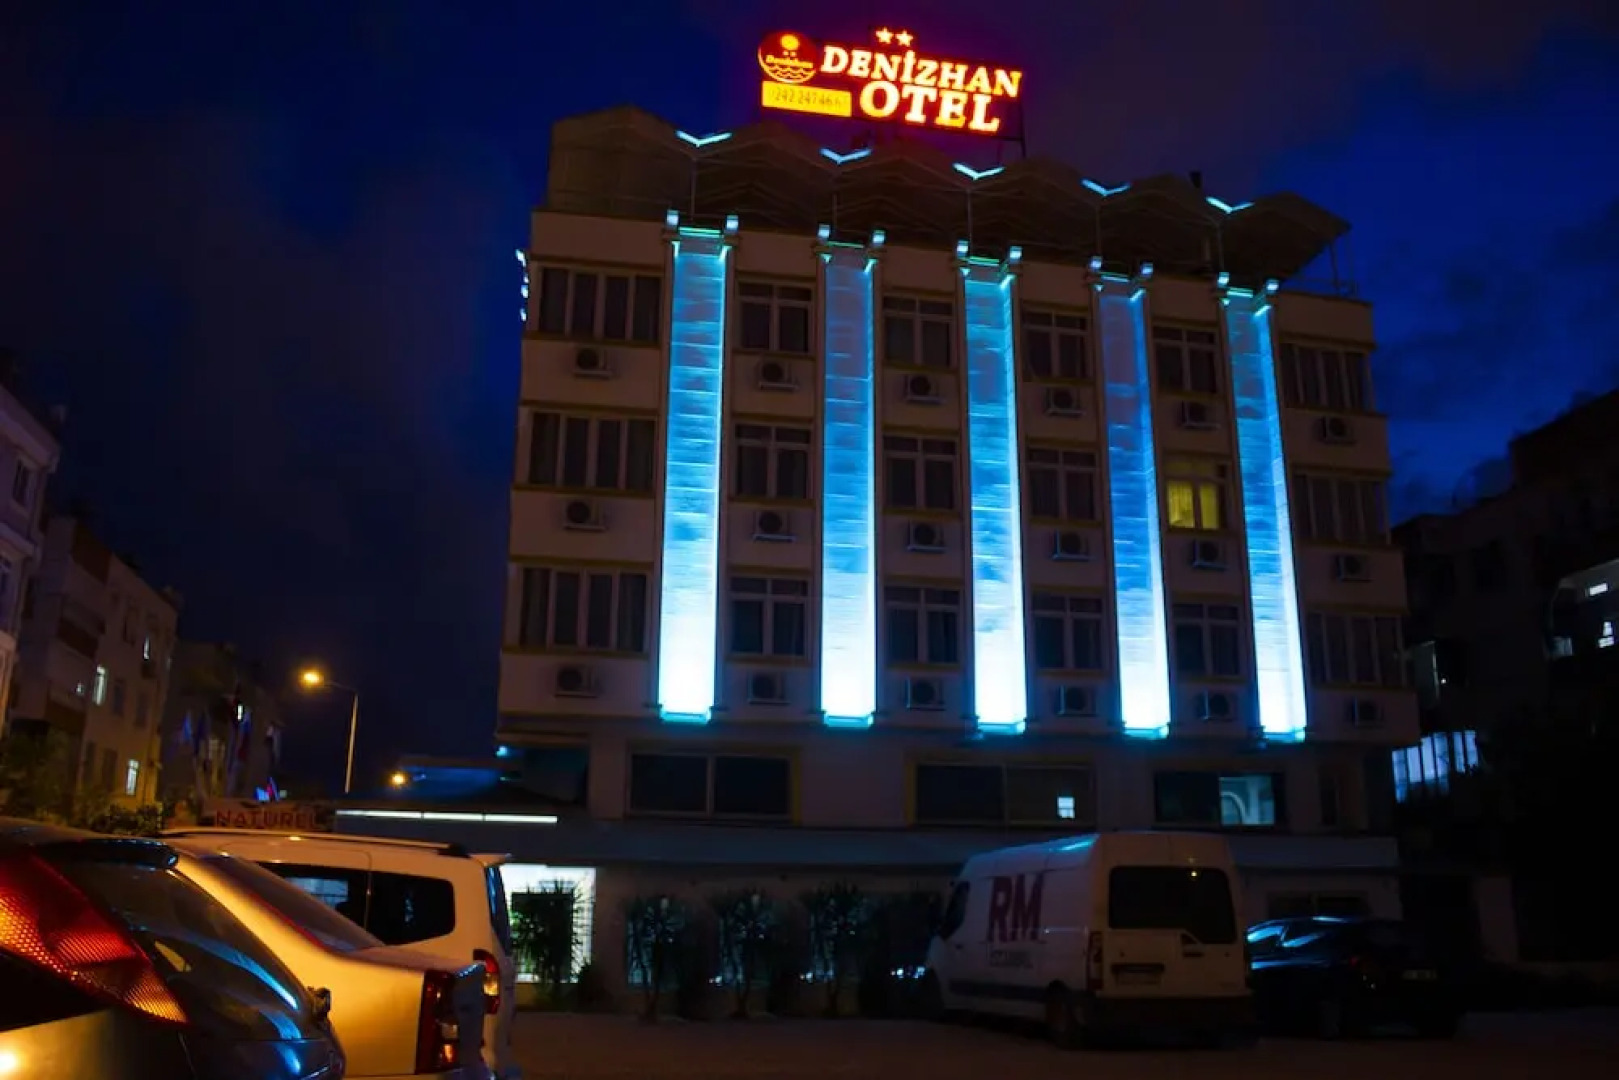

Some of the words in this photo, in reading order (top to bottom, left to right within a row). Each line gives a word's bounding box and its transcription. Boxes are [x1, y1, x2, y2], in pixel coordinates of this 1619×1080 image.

[821, 45, 1022, 97] DENİZHAN
[859, 80, 1000, 132] OTEL
[987, 872, 1043, 942] RM
